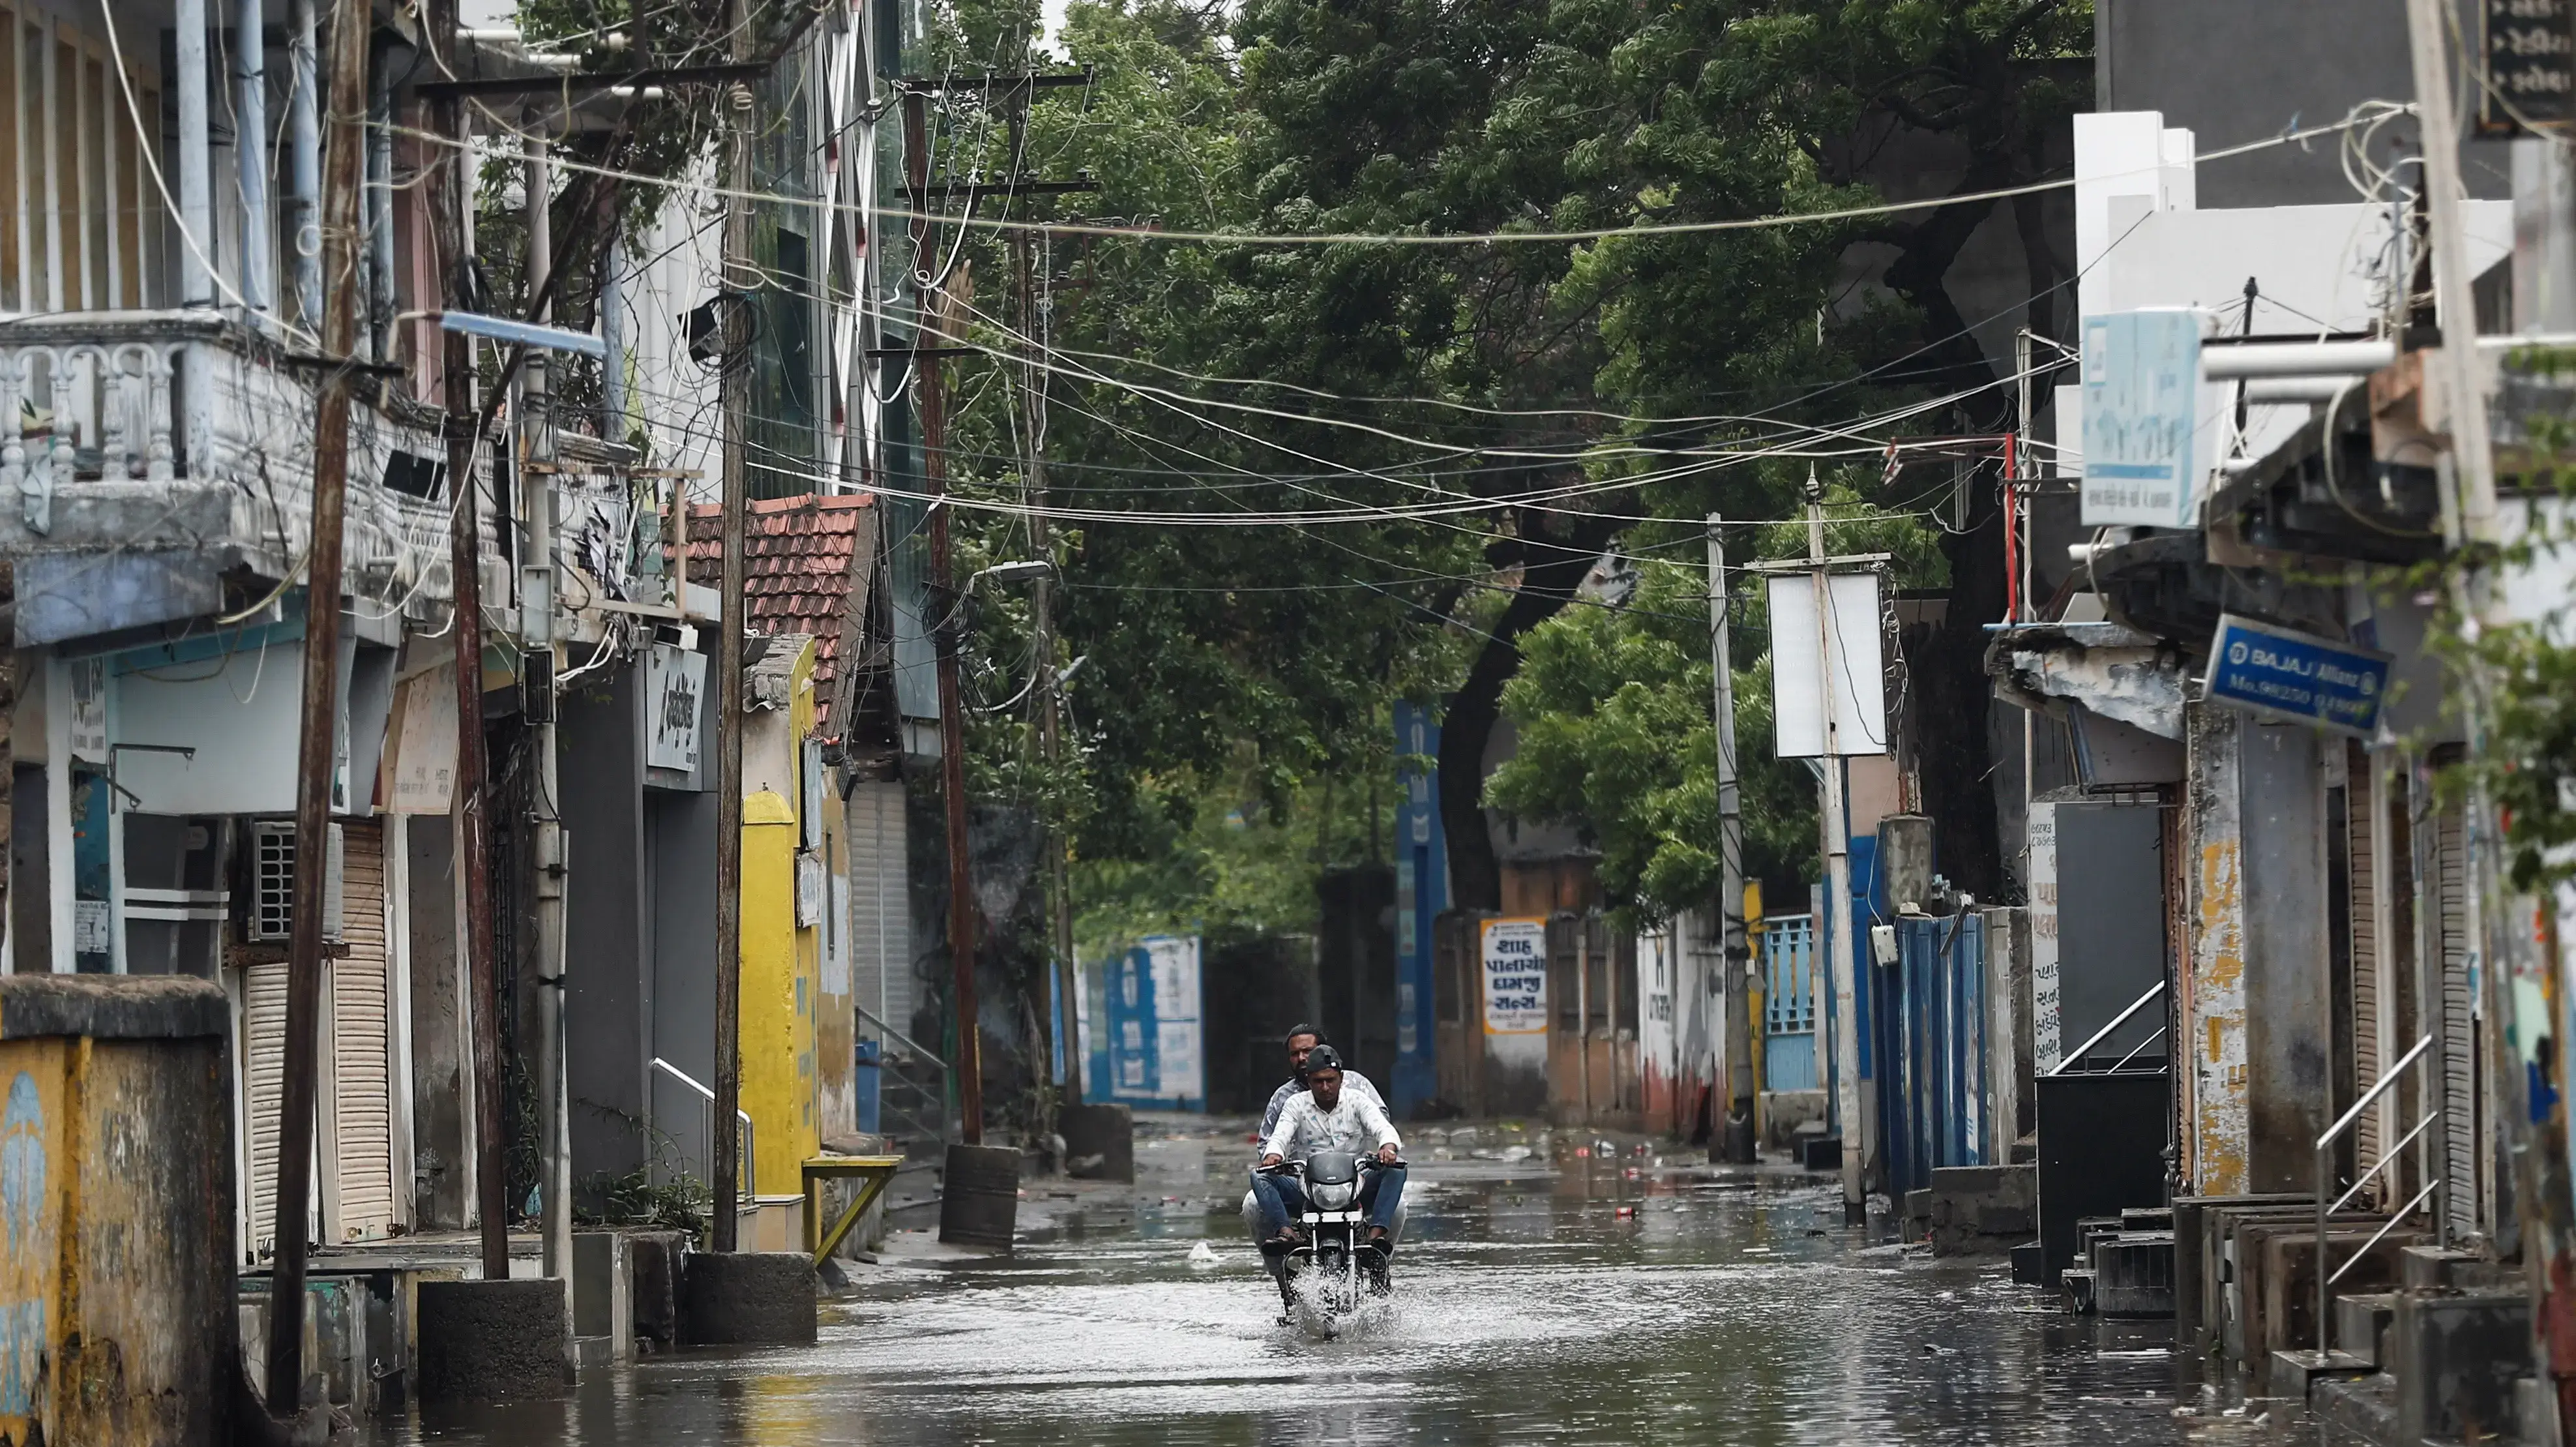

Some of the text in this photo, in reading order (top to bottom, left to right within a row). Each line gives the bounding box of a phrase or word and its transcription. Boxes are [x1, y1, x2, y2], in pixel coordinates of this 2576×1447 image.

[2251, 649, 2313, 676] BAJAJ
[1496, 939, 1532, 955] શાહ
[1493, 977, 1541, 993] દામજી
[1495, 996, 1535, 1010] સન્સ
